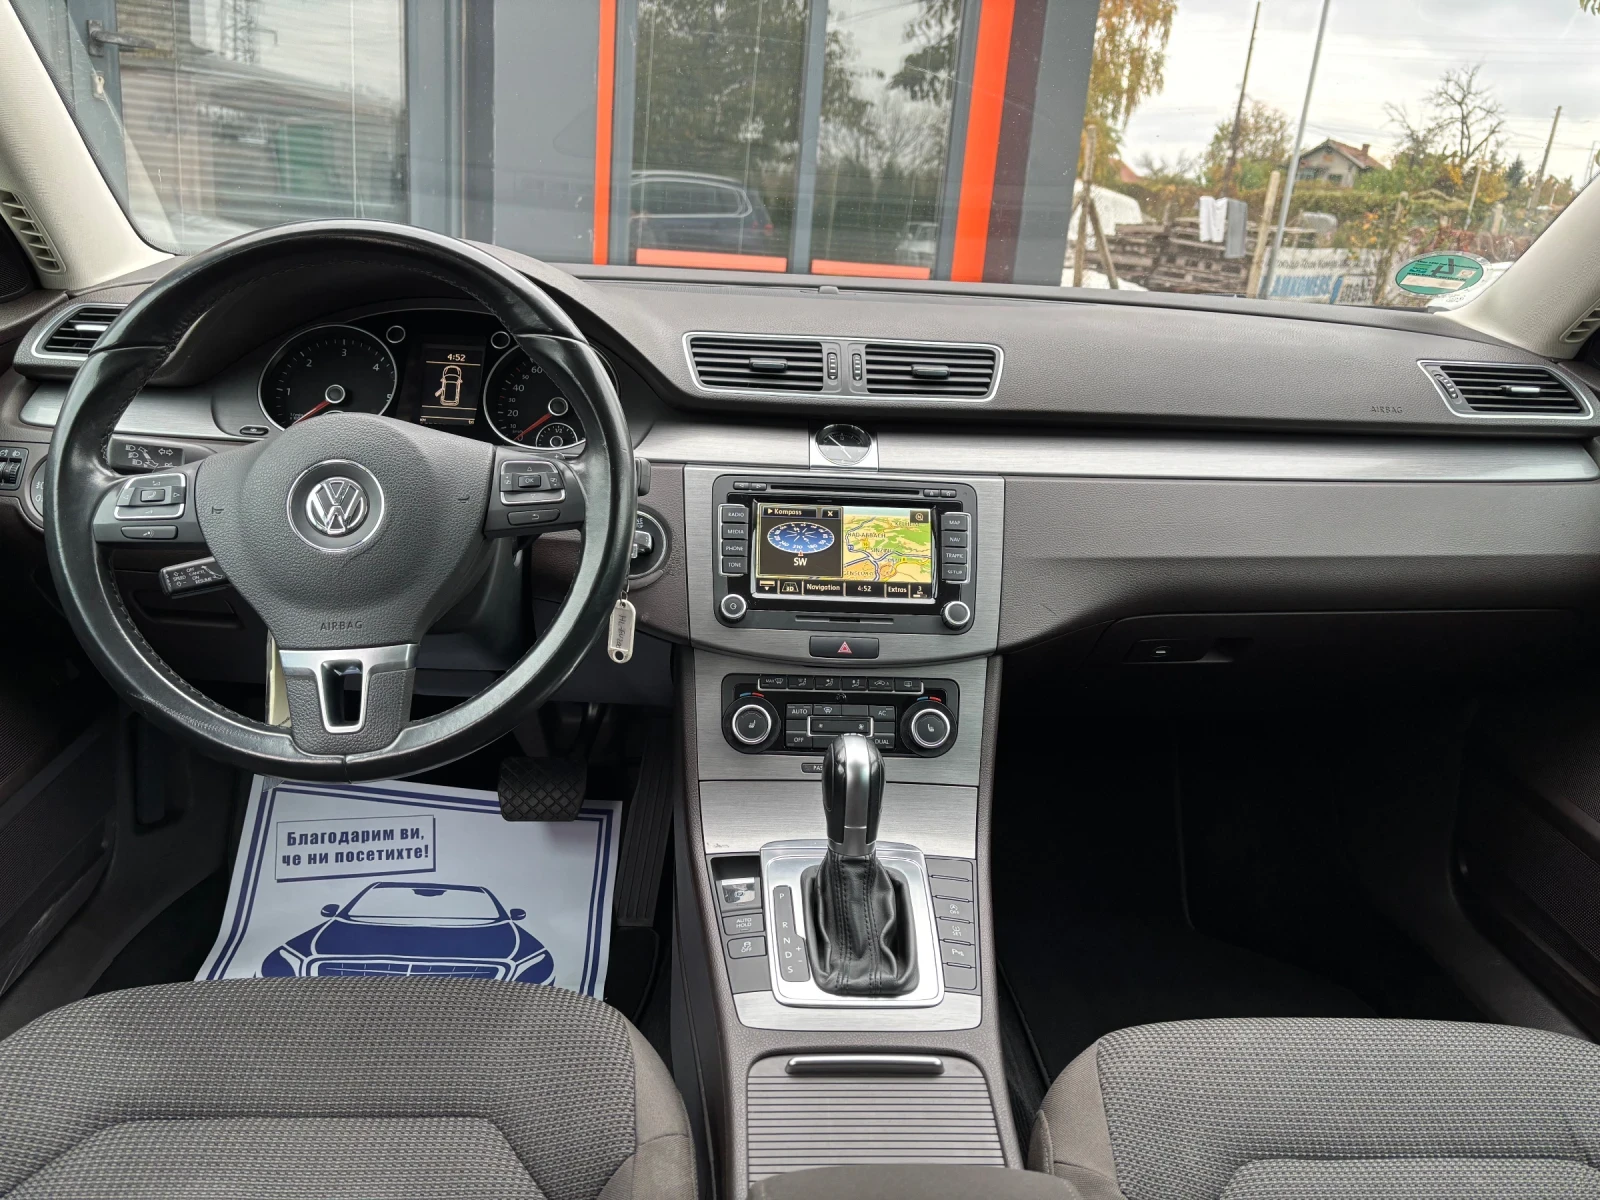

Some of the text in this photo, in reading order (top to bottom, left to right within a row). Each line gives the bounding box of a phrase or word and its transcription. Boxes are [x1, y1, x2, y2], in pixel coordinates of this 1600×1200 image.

[341, 348, 347, 357] 3
[447, 353, 466, 362] 4:52
[306, 359, 312, 367] 2
[372, 363, 380, 372] 4
[531, 366, 543, 374] 60
[286, 387, 291, 396] 1
[512, 384, 525, 392] 40
[507, 409, 519, 417] 20
[1371, 405, 1403, 414] AIRBAG
[774, 508, 802, 516] Kompass
[793, 557, 808, 566] SW
[806, 583, 841, 591] Navigation
[320, 620, 363, 631] AIRBAG
[791, 708, 808, 716] AUTO
[287, 827, 425, 846] Благодарим ви,
[282, 844, 429, 866] че ни посетихте!
[782, 921, 788, 929] R
[741, 945, 753, 953] OFF
[784, 951, 793, 959] D
[787, 965, 794, 974] S
